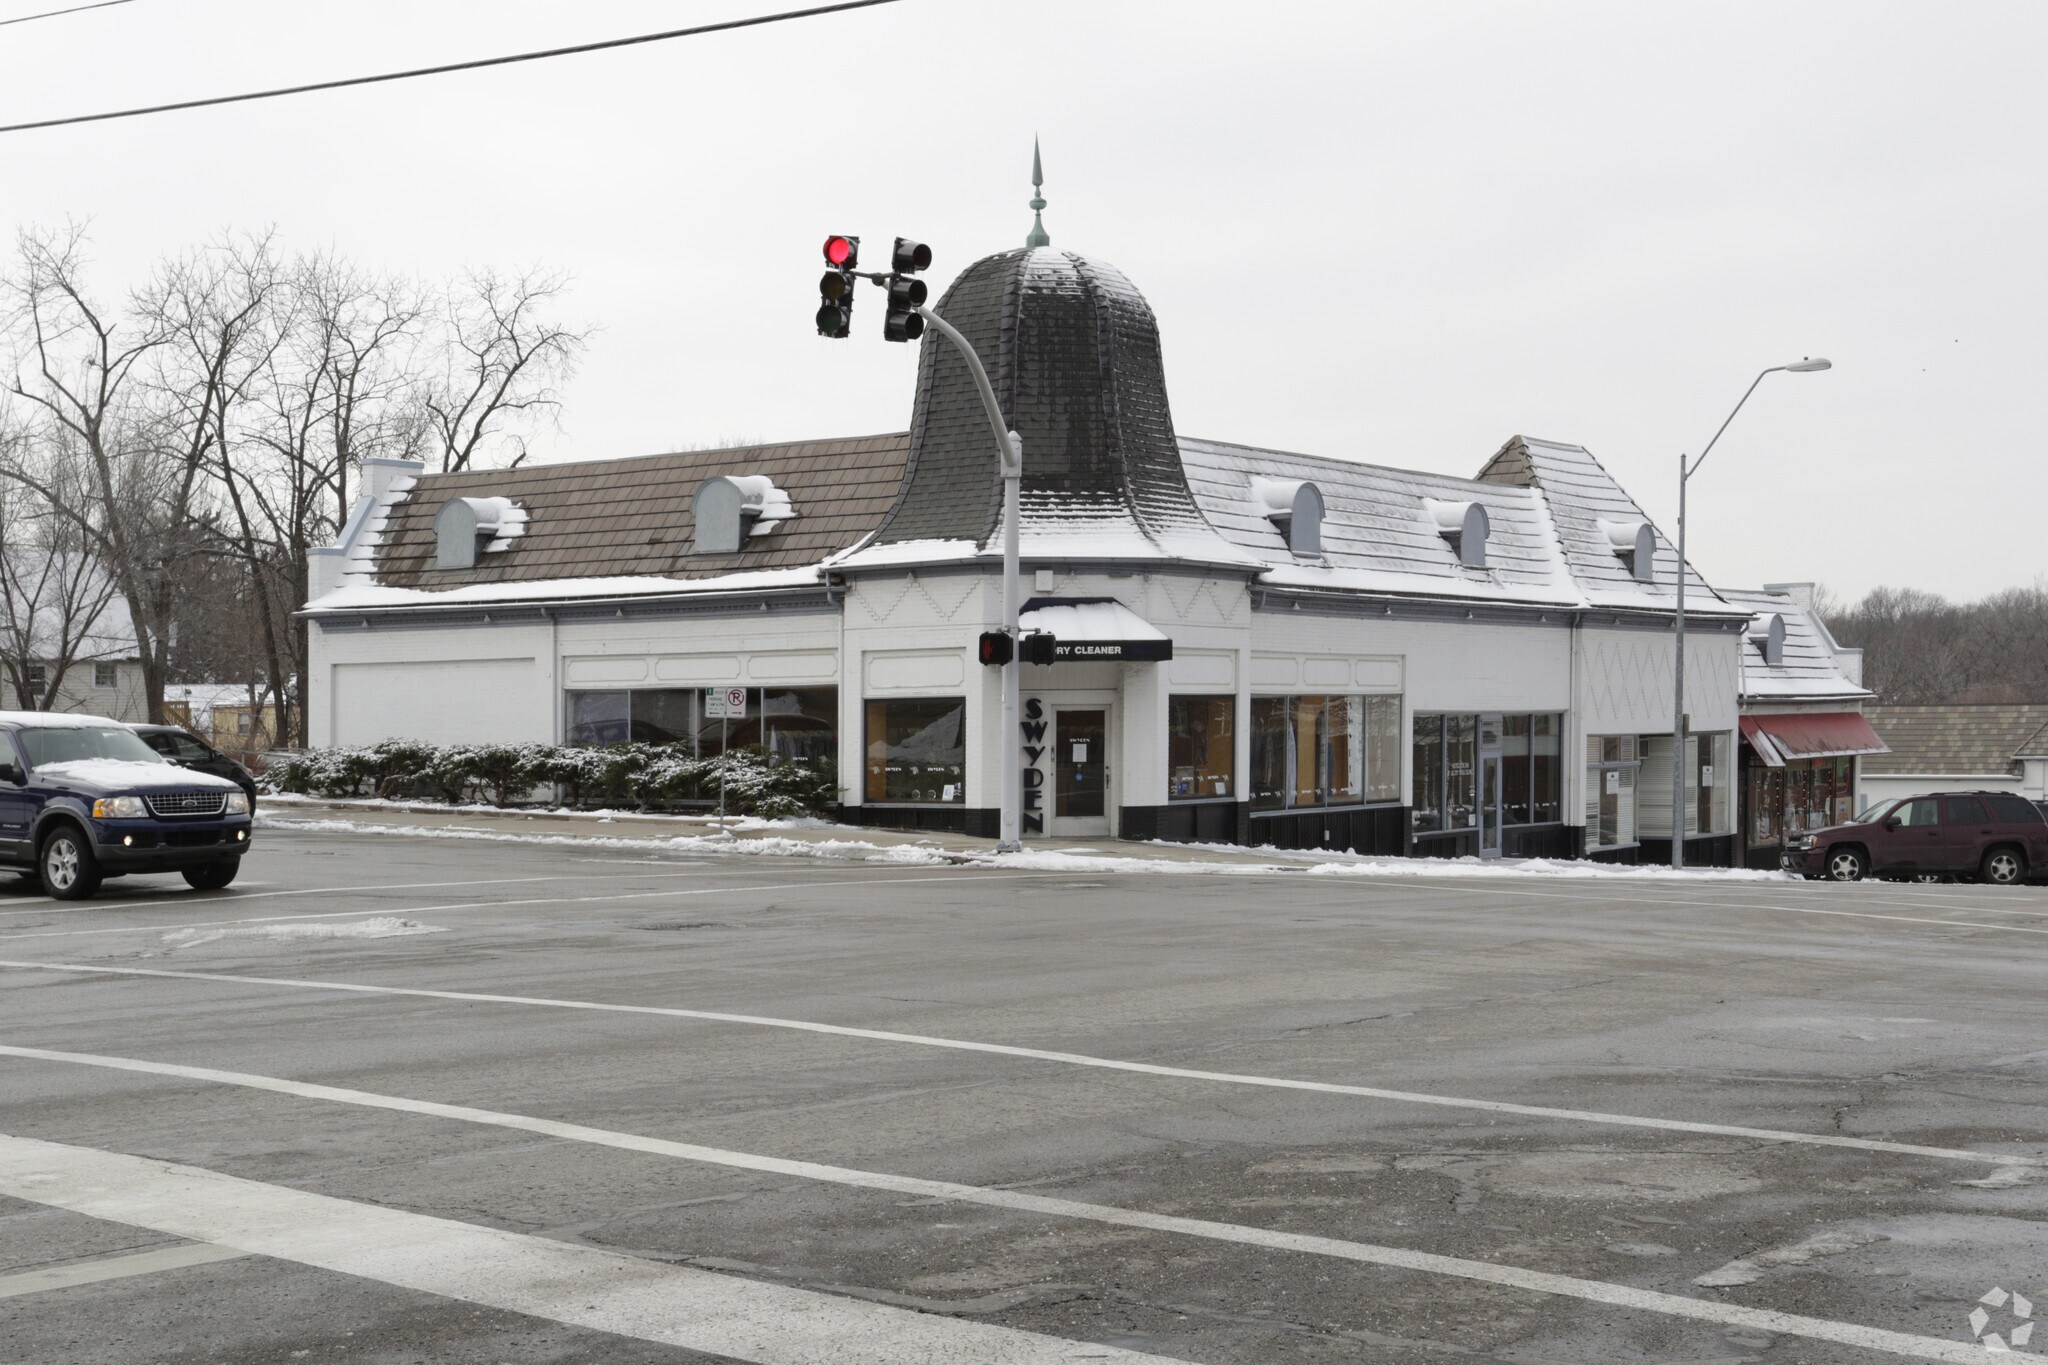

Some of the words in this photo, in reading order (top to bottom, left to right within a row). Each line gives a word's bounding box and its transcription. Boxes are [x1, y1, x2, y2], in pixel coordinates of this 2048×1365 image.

[1055, 646, 1071, 655] RY
[1074, 645, 1122, 655] CLEANER
[1020, 697, 1048, 834] SWYDEN
